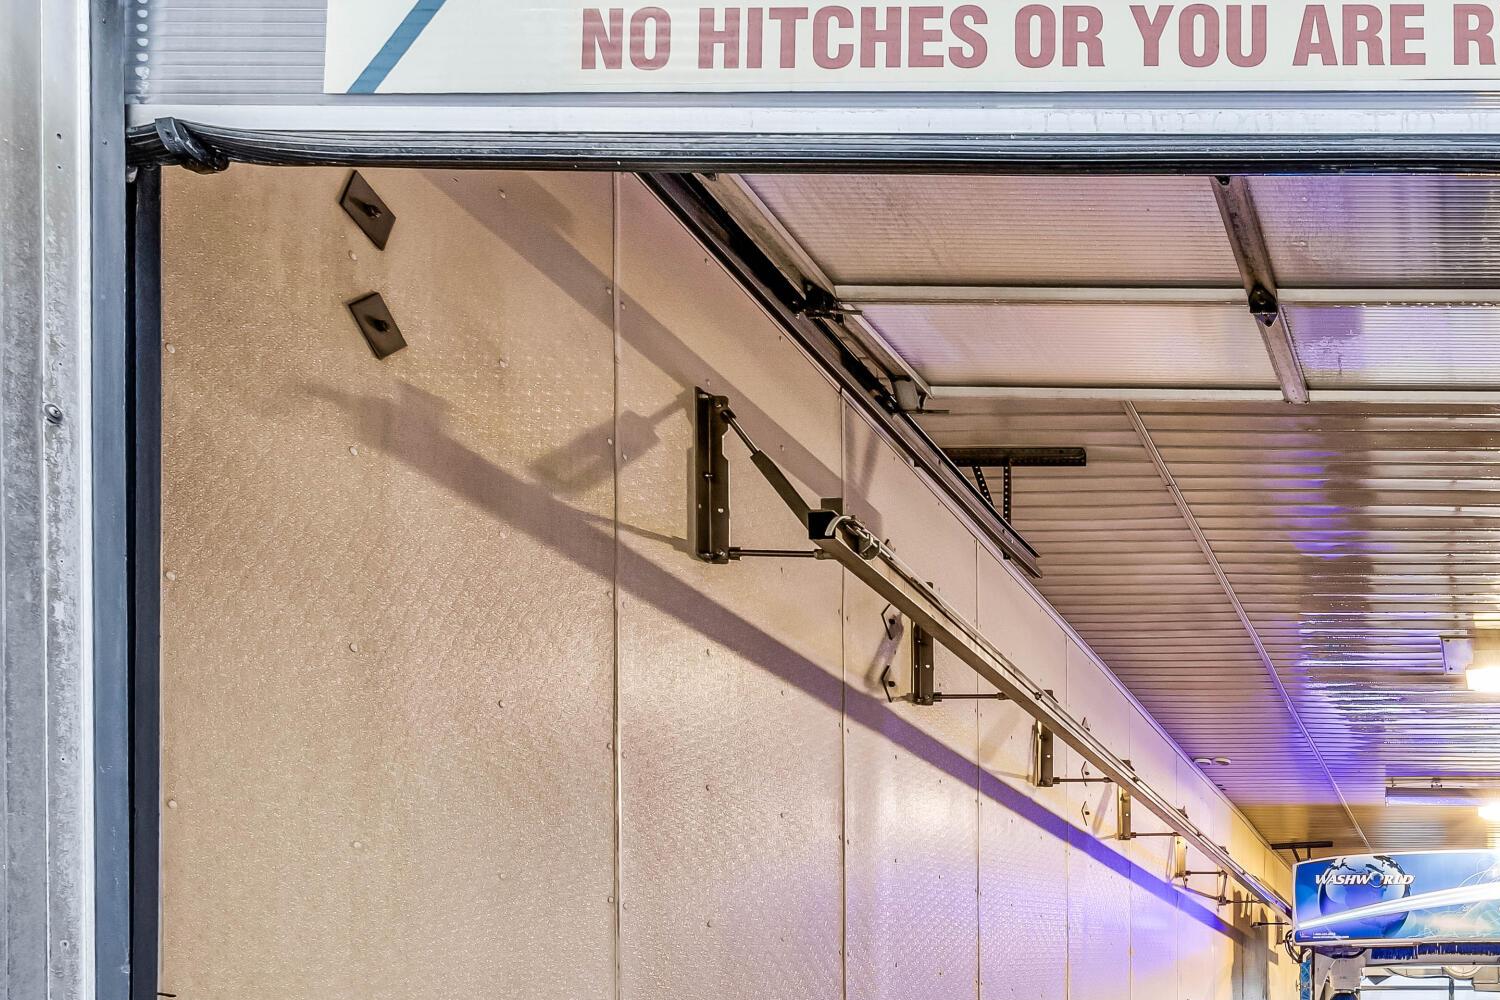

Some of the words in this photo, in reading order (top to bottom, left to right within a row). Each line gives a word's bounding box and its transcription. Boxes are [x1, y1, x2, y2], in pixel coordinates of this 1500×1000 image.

[584, 10, 669, 69] NO
[700, 6, 986, 69] HITCHES
[1016, 5, 1103, 67] OR
[1132, 4, 1266, 67] YOU
[1294, 4, 1425, 66] ARE
[1315, 871, 1414, 887] WASHWORLD
